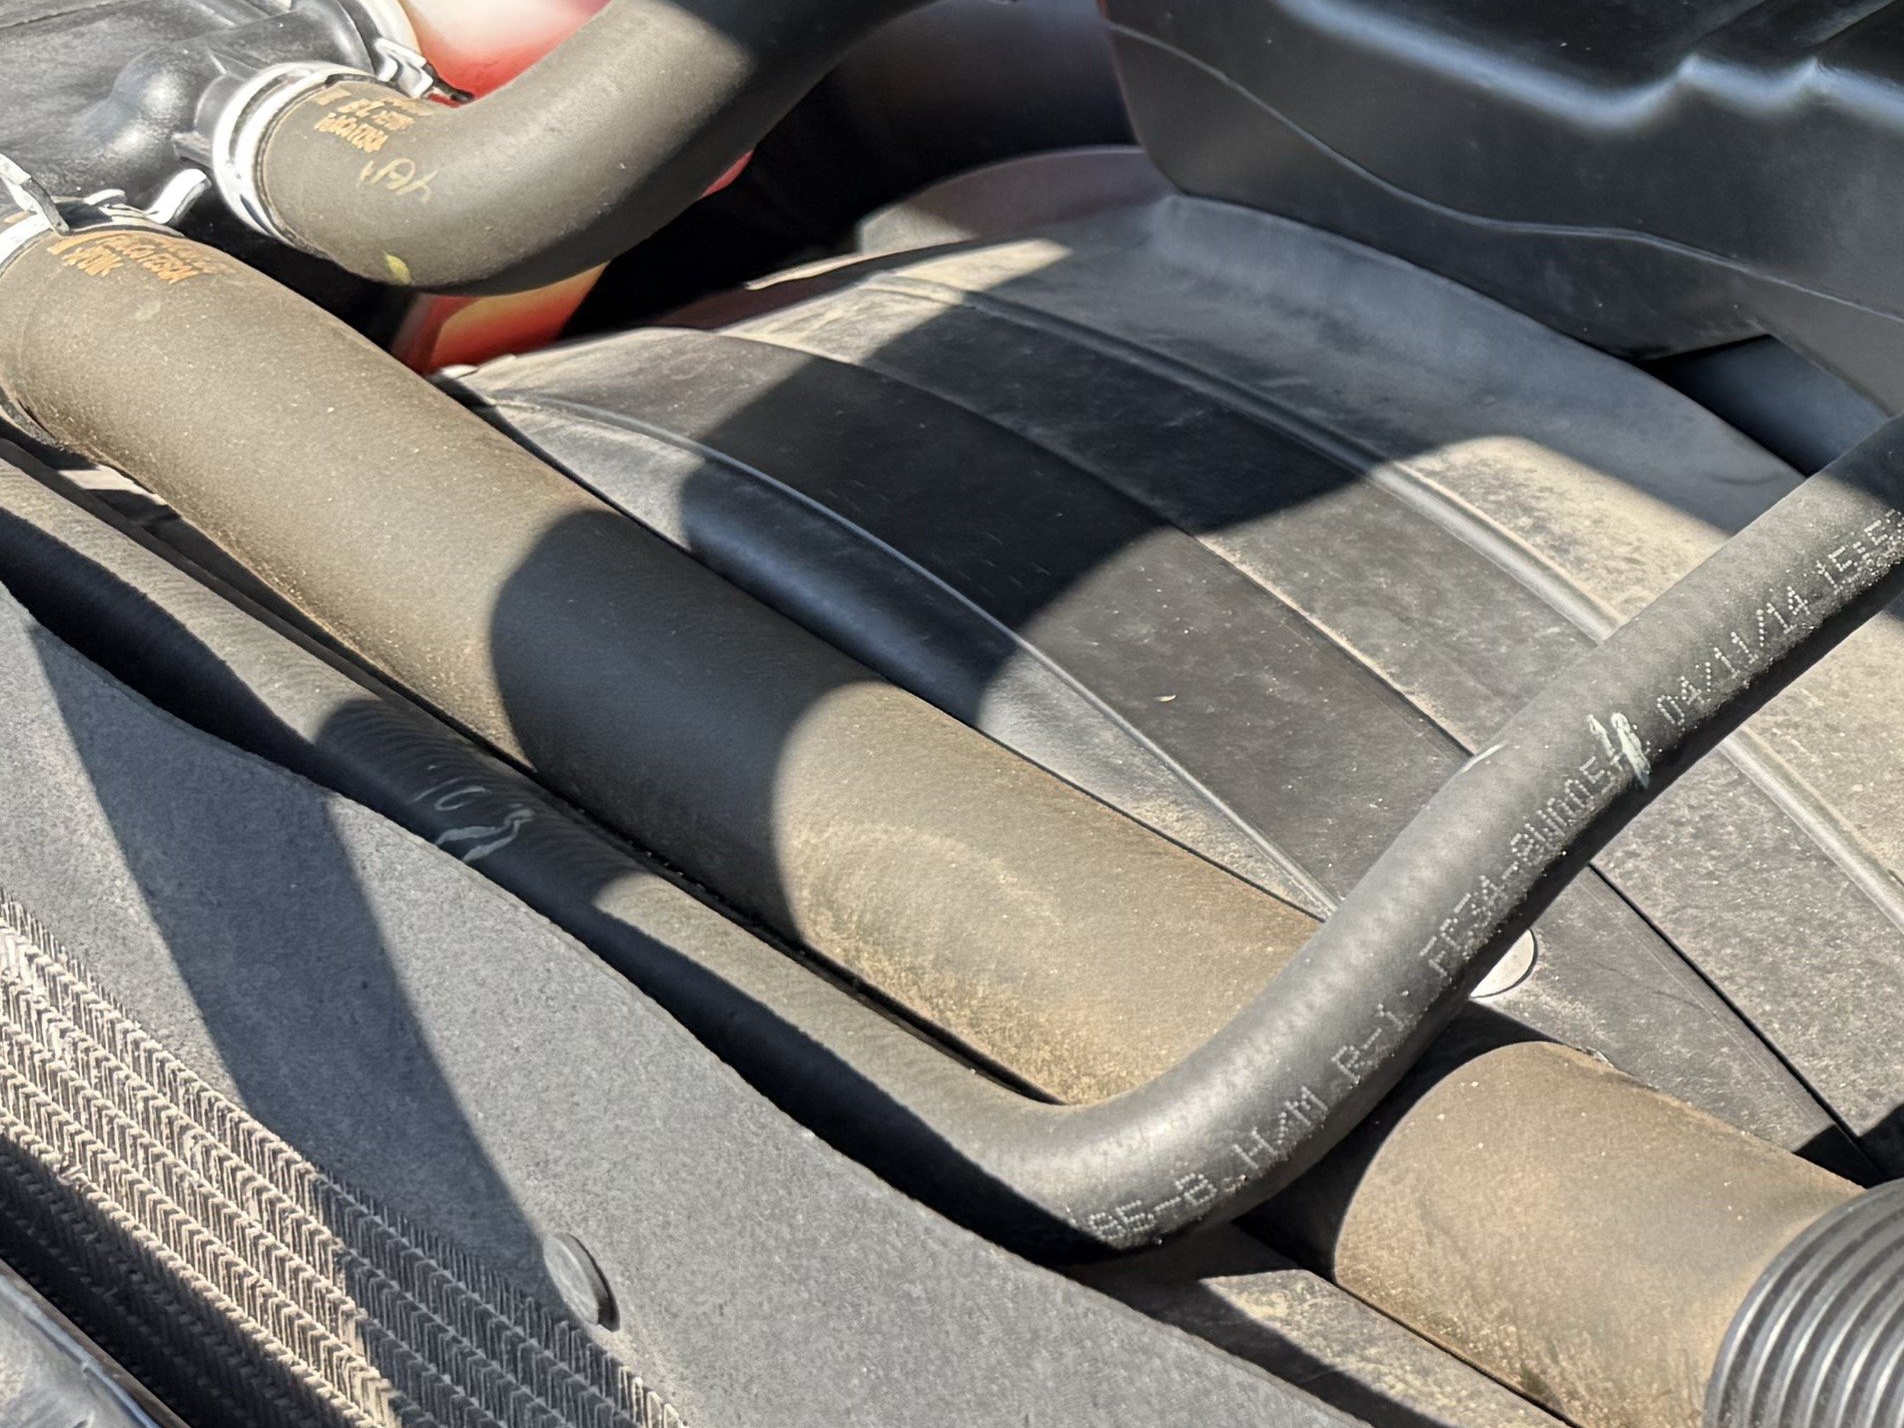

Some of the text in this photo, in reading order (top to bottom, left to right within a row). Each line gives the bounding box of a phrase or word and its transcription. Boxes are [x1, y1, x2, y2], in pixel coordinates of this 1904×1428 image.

[1228, 1082, 1332, 1176] H/M
[1412, 727, 1662, 982] FC34-8W005-
[1656, 582, 1824, 730] 04/11/14
